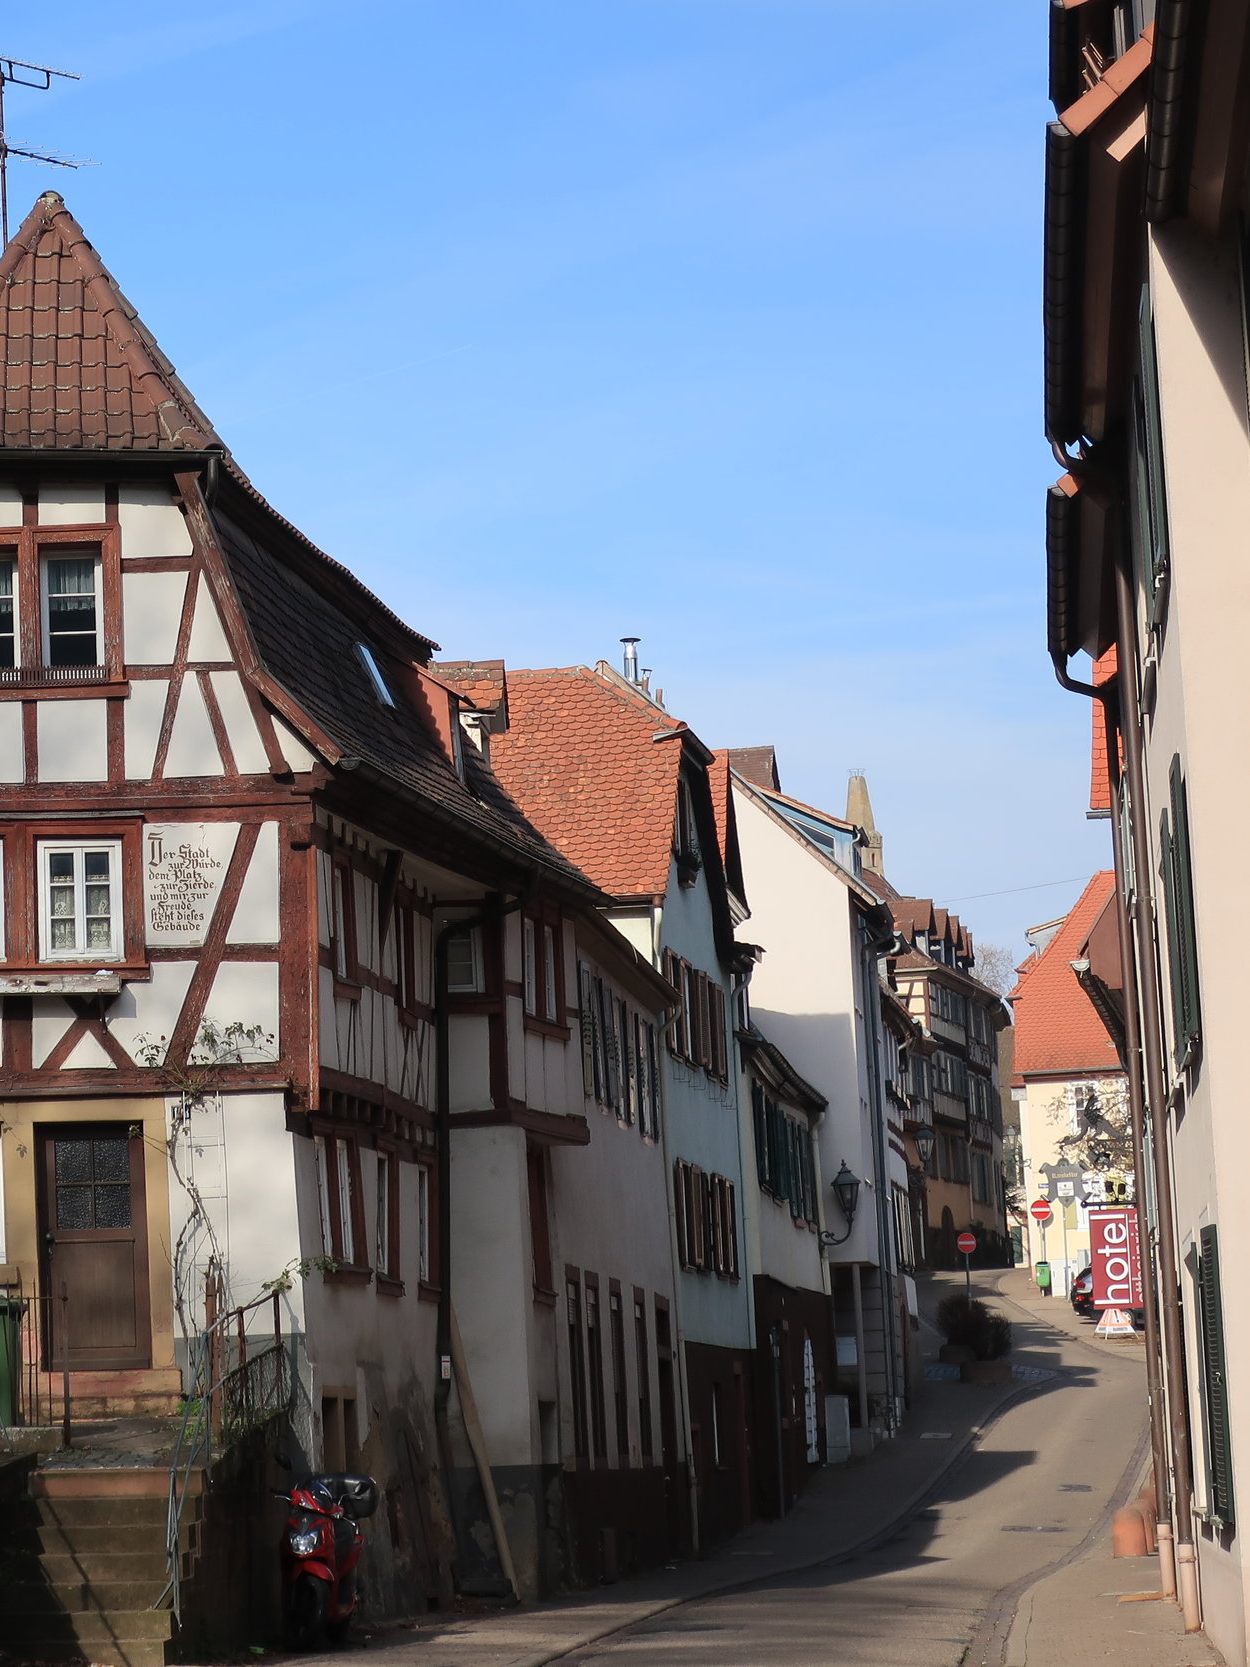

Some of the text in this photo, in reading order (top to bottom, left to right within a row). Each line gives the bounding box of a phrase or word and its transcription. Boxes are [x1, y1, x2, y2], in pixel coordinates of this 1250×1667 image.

[148, 831, 210, 867] Der Stadt
[168, 862, 185, 872] zur
[148, 867, 171, 880] dem
[154, 883, 178, 892] zur
[150, 891, 168, 900] und
[187, 893, 209, 902] zur
[158, 900, 191, 914] Freude
[153, 921, 201, 931] Gebäude
[1090, 1213, 1130, 1304] hotel
